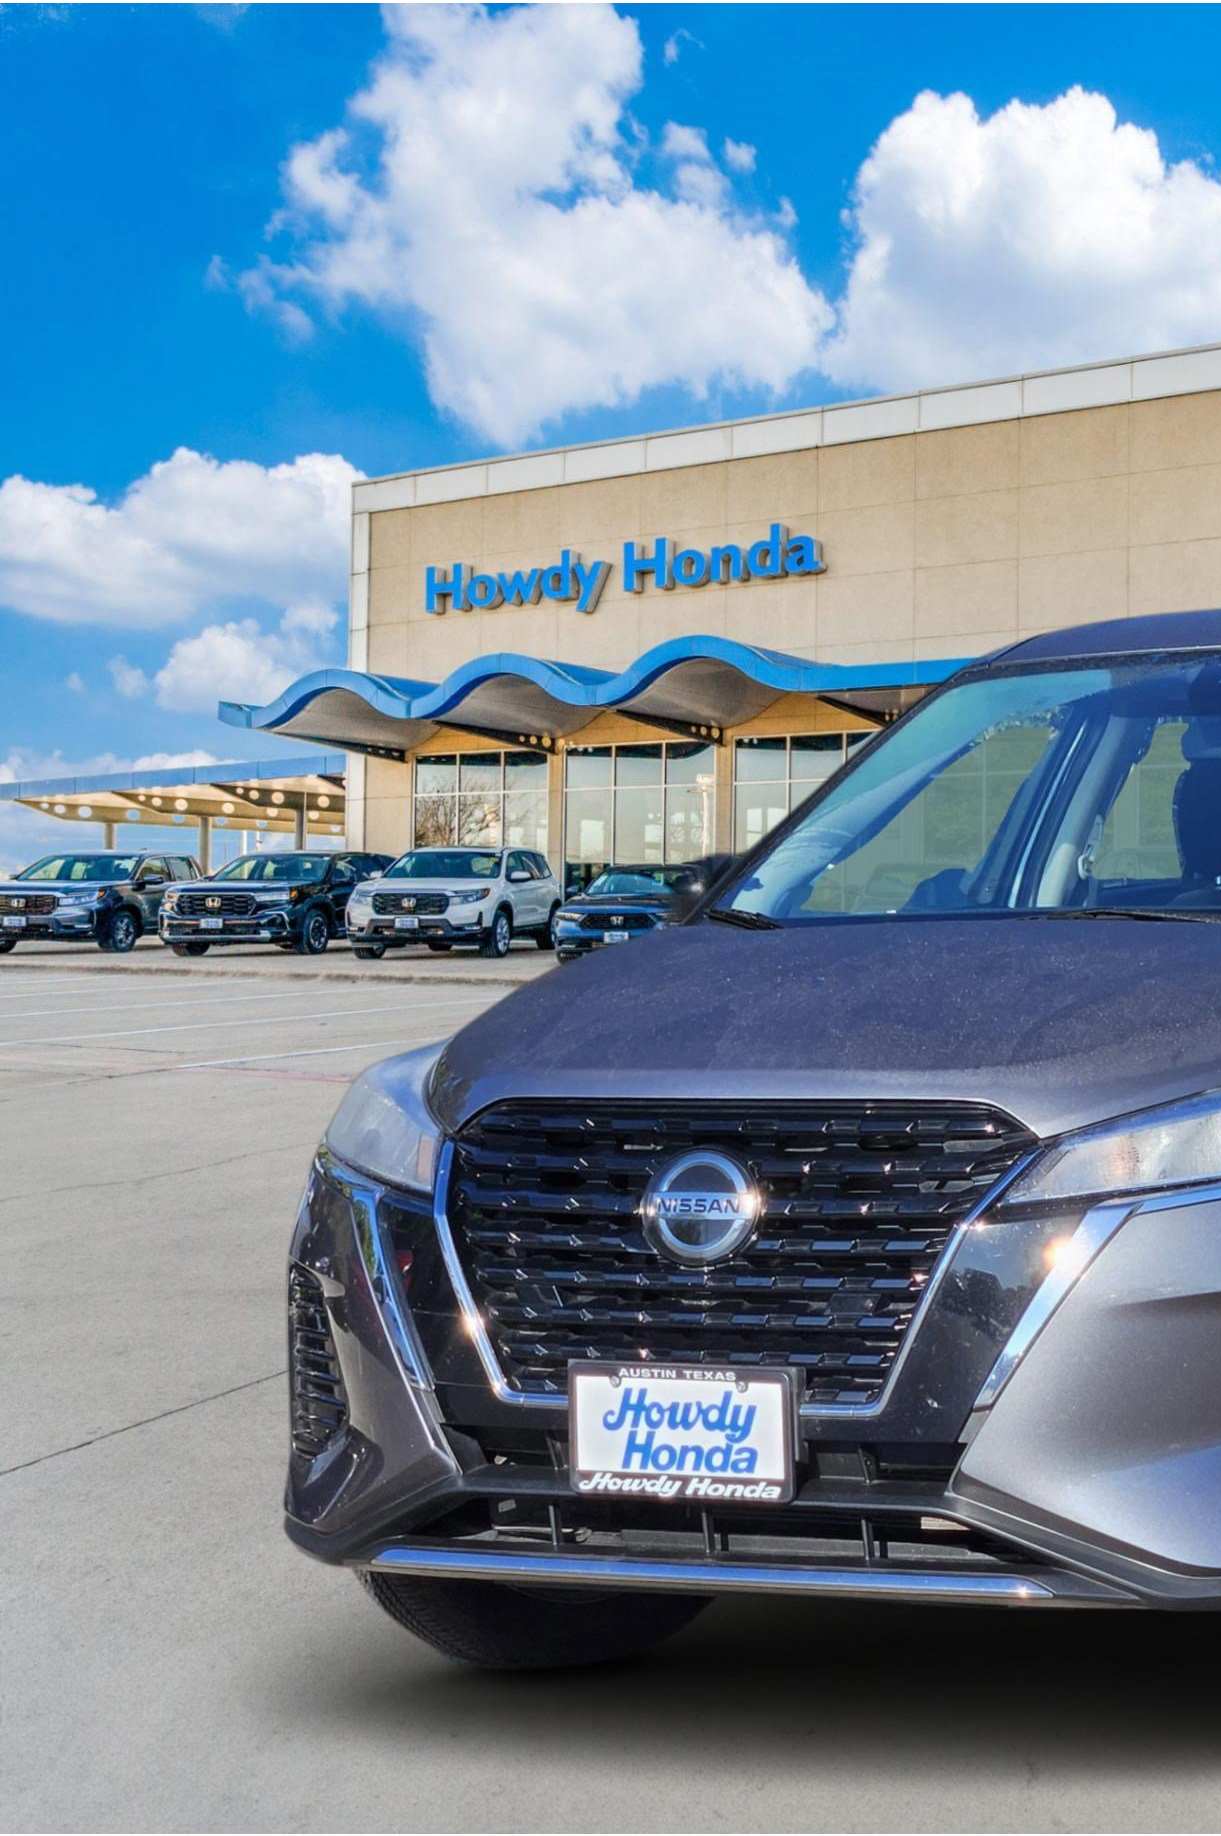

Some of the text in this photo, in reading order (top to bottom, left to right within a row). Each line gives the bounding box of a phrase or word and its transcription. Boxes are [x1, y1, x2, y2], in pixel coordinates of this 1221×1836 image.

[425, 523, 826, 614] Howdy Honda
[657, 1198, 740, 1214] NISSAN
[618, 1367, 737, 1382] AUSTIN TEXAS
[602, 1388, 757, 1443] Howdy
[621, 1430, 759, 1474] Honda
[579, 1472, 782, 1500] Howdy Honda
